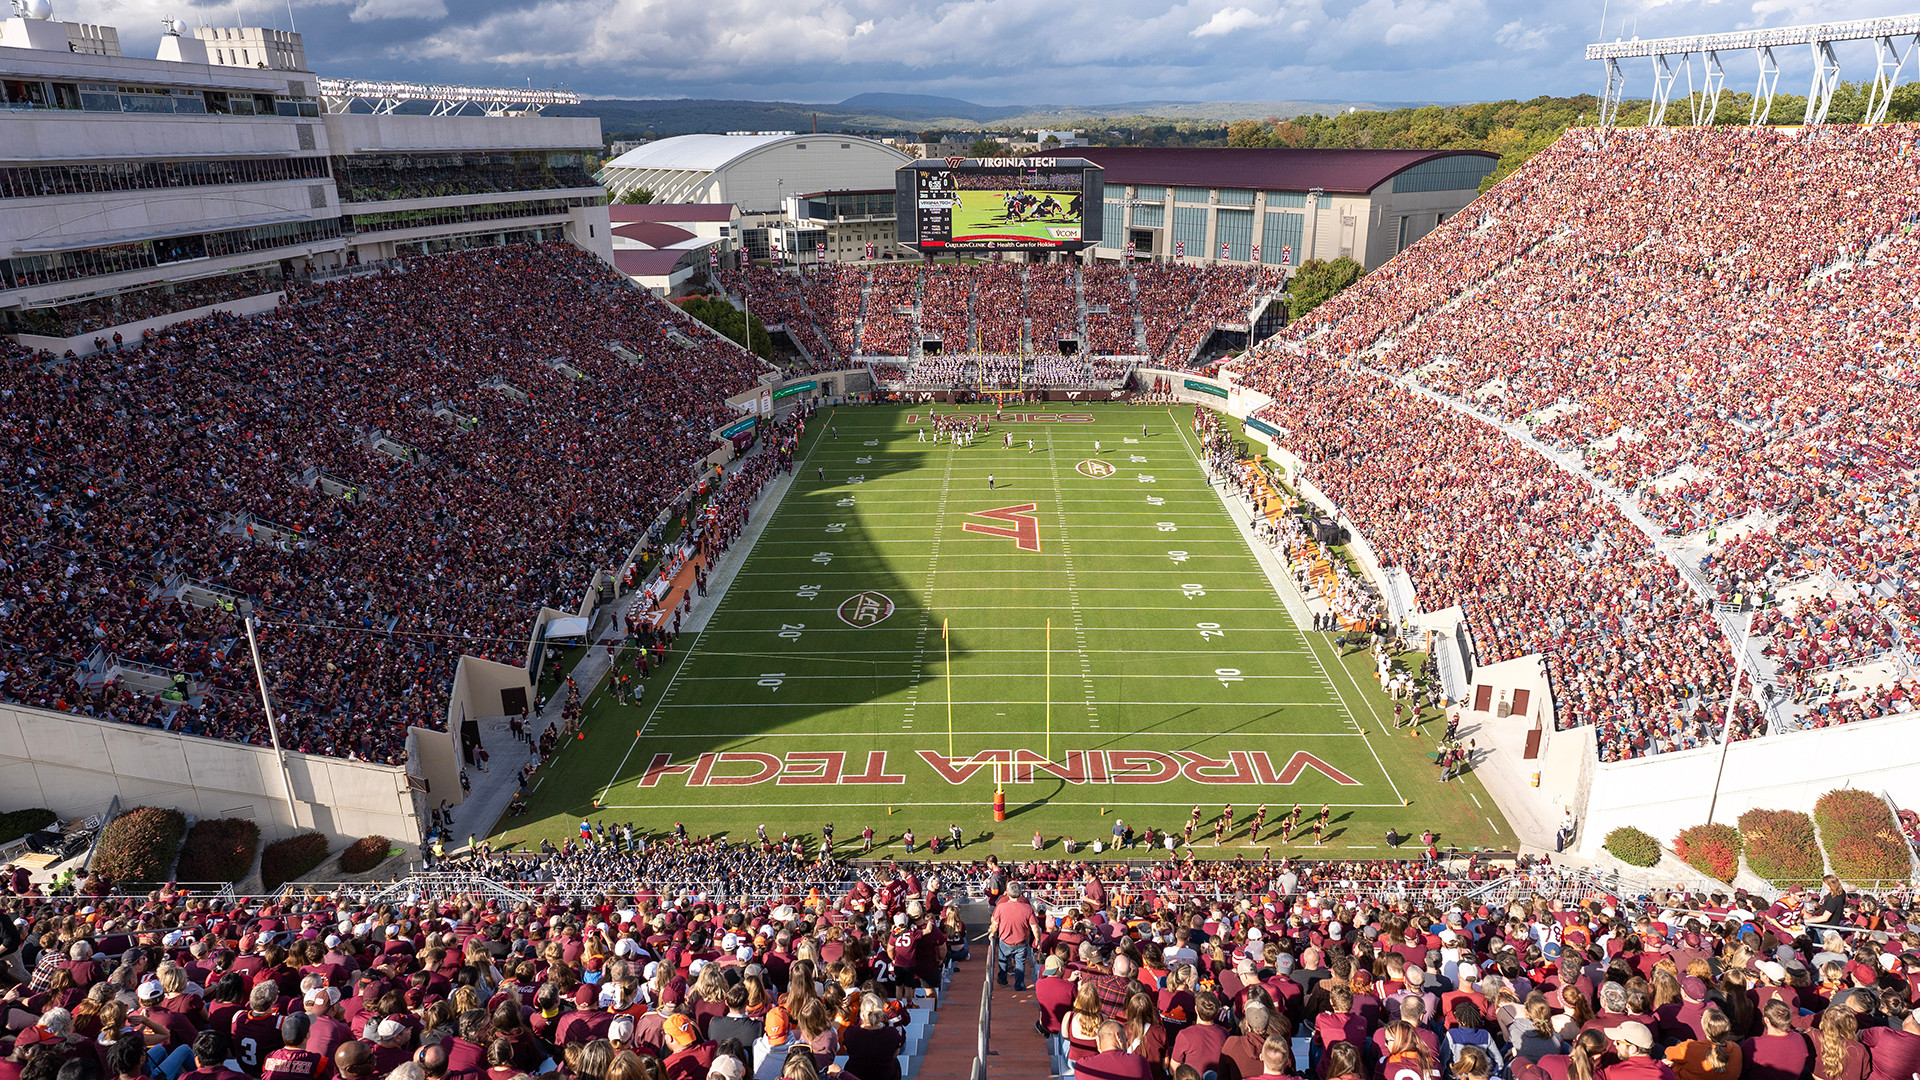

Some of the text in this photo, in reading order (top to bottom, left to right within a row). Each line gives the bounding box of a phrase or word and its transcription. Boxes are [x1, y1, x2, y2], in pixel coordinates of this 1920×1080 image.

[944, 157, 965, 168] VT
[976, 157, 1057, 168] VIRGINIA TECH
[1066, 391, 1081, 399] VT
[825, 523, 846, 533] 50
[962, 502, 1042, 553] VT
[1156, 522, 1178, 532] 50
[811, 552, 833, 563] 40
[1168, 550, 1190, 563] 40
[797, 584, 822, 597] 30
[1181, 583, 1206, 596] 30
[858, 596, 881, 622] ACC
[778, 623, 805, 639] 20
[1196, 622, 1224, 638] 20
[757, 672, 786, 687] 10
[1215, 668, 1245, 683] 10
[637, 748, 1365, 788] VIRGINIA TECH
[1779, 911, 1800, 926] 25
[895, 932, 911, 947] 25
[1542, 926, 1561, 942] 78
[678, 1022, 690, 1032] VT
[241, 1037, 257, 1066] 3
